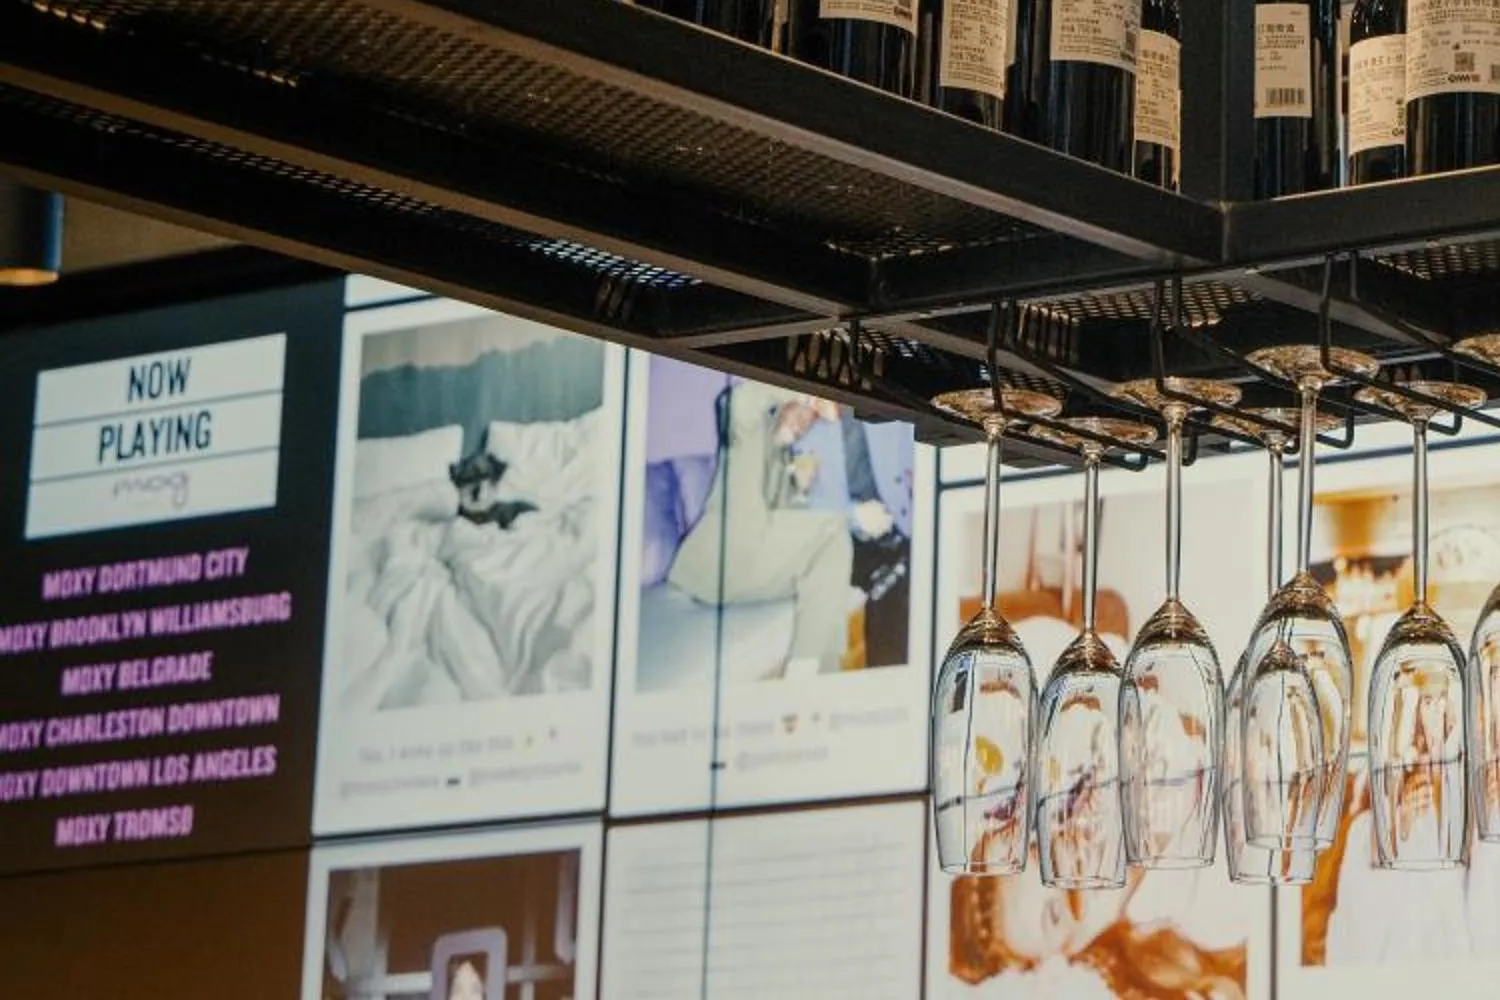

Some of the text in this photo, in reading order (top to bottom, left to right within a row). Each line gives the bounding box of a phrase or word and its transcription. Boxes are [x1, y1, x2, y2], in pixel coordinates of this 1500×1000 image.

[127, 356, 192, 403] NOW
[98, 409, 212, 464] PLAYING
[43, 547, 249, 600] MOXY DORTMUND CITY
[50, 610, 147, 648] BROOKLYN
[149, 592, 291, 636] WILLIAMSBURG
[61, 652, 213, 696] MOXY BELGRADE
[45, 706, 166, 747] CHARLESTON
[166, 694, 280, 732] DOWNTOWN
[0, 746, 277, 802] OXY DOWNTOWN LOS ANGELES
[55, 813, 111, 847] MOXY
